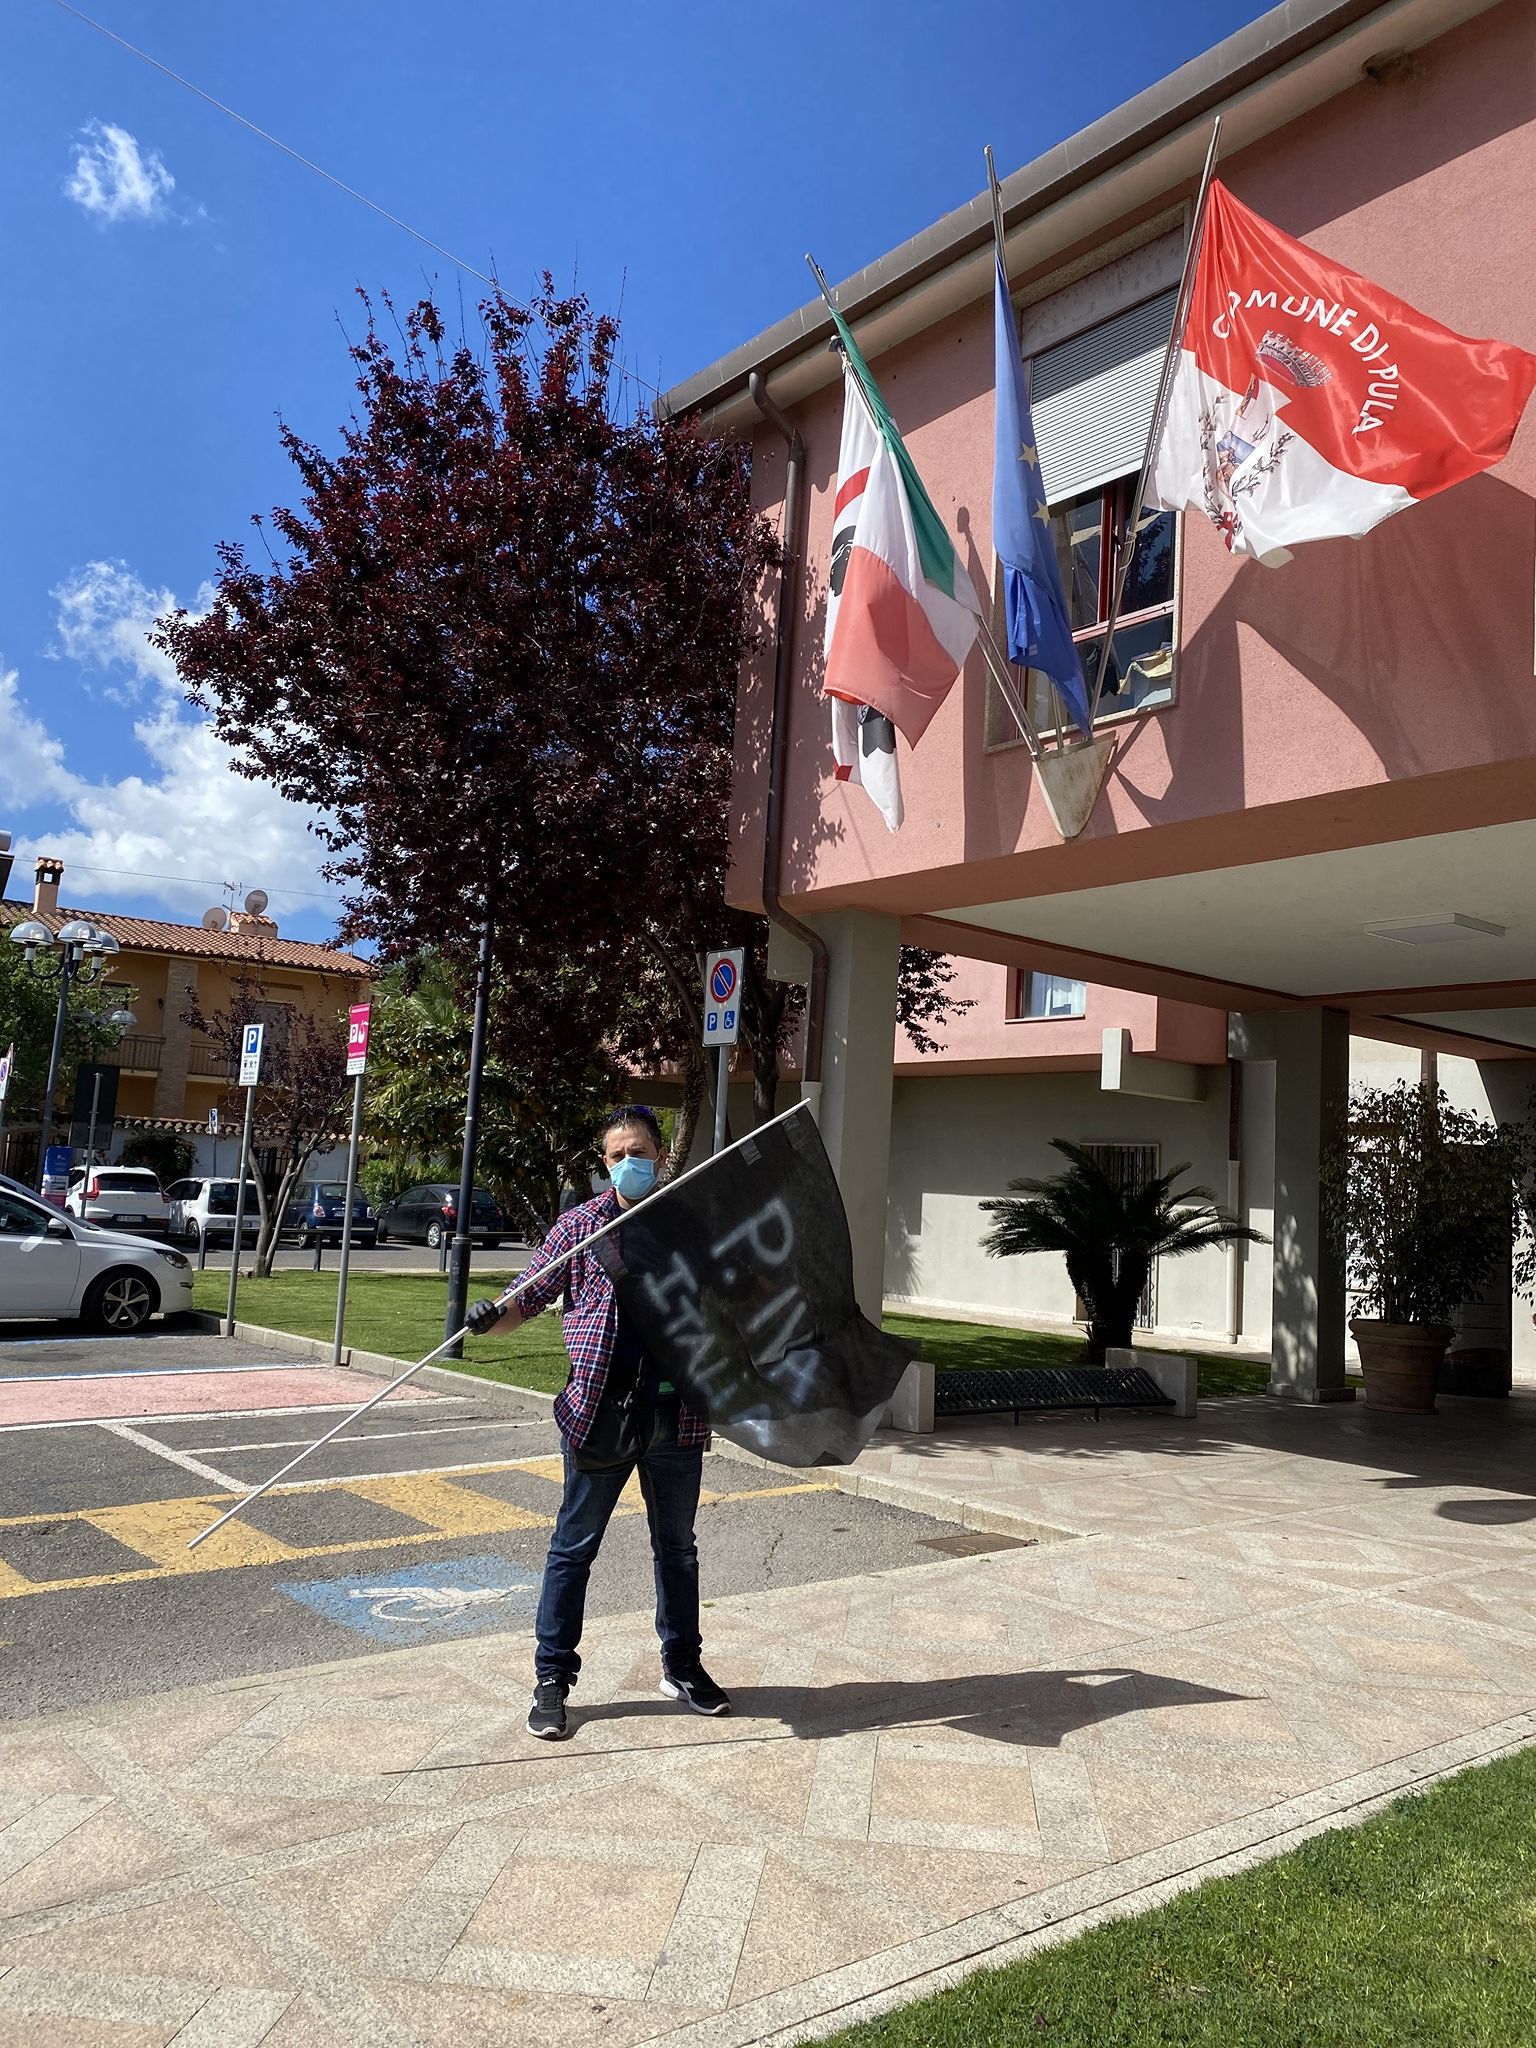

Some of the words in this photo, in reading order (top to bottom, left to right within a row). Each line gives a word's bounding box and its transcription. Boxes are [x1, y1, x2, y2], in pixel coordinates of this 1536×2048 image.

[1212, 289, 1358, 339] COMUNE
[1350, 322, 1389, 362] DI
[1353, 363, 1400, 435] PULA
[247, 1030, 257, 1051] P
[709, 1015, 716, 1029] P
